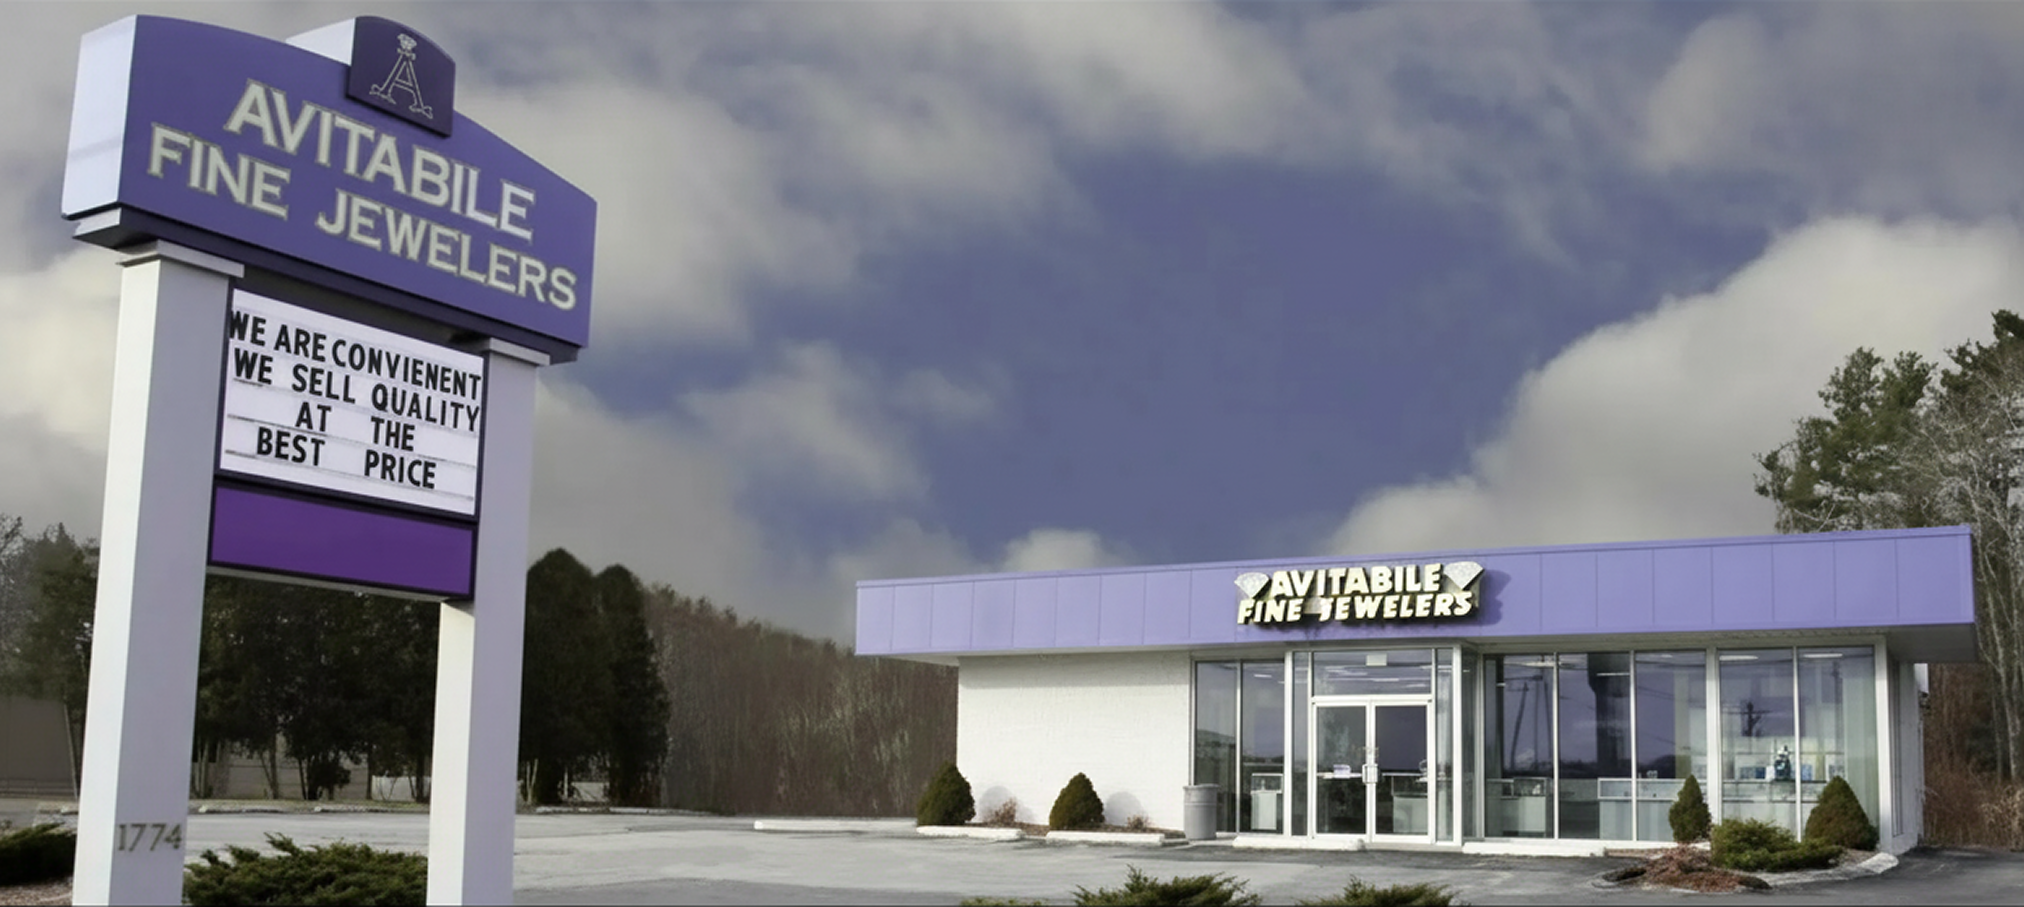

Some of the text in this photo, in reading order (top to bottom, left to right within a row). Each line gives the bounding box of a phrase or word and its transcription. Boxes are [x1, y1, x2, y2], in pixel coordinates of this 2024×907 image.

[369, 48, 434, 119] A
[224, 78, 536, 243] AVITABILE
[147, 122, 578, 312] FINE JEWELERS
[230, 310, 482, 400] WE ARE CONVIENENT
[234, 347, 480, 432] WE SELL QUALITY
[256, 426, 437, 490] BEST PRICE
[295, 401, 415, 452] AT THE
[1237, 591, 1472, 624] FINE JEWELERS
[1270, 563, 1443, 597] AVITABILE
[118, 823, 183, 852] 1774
